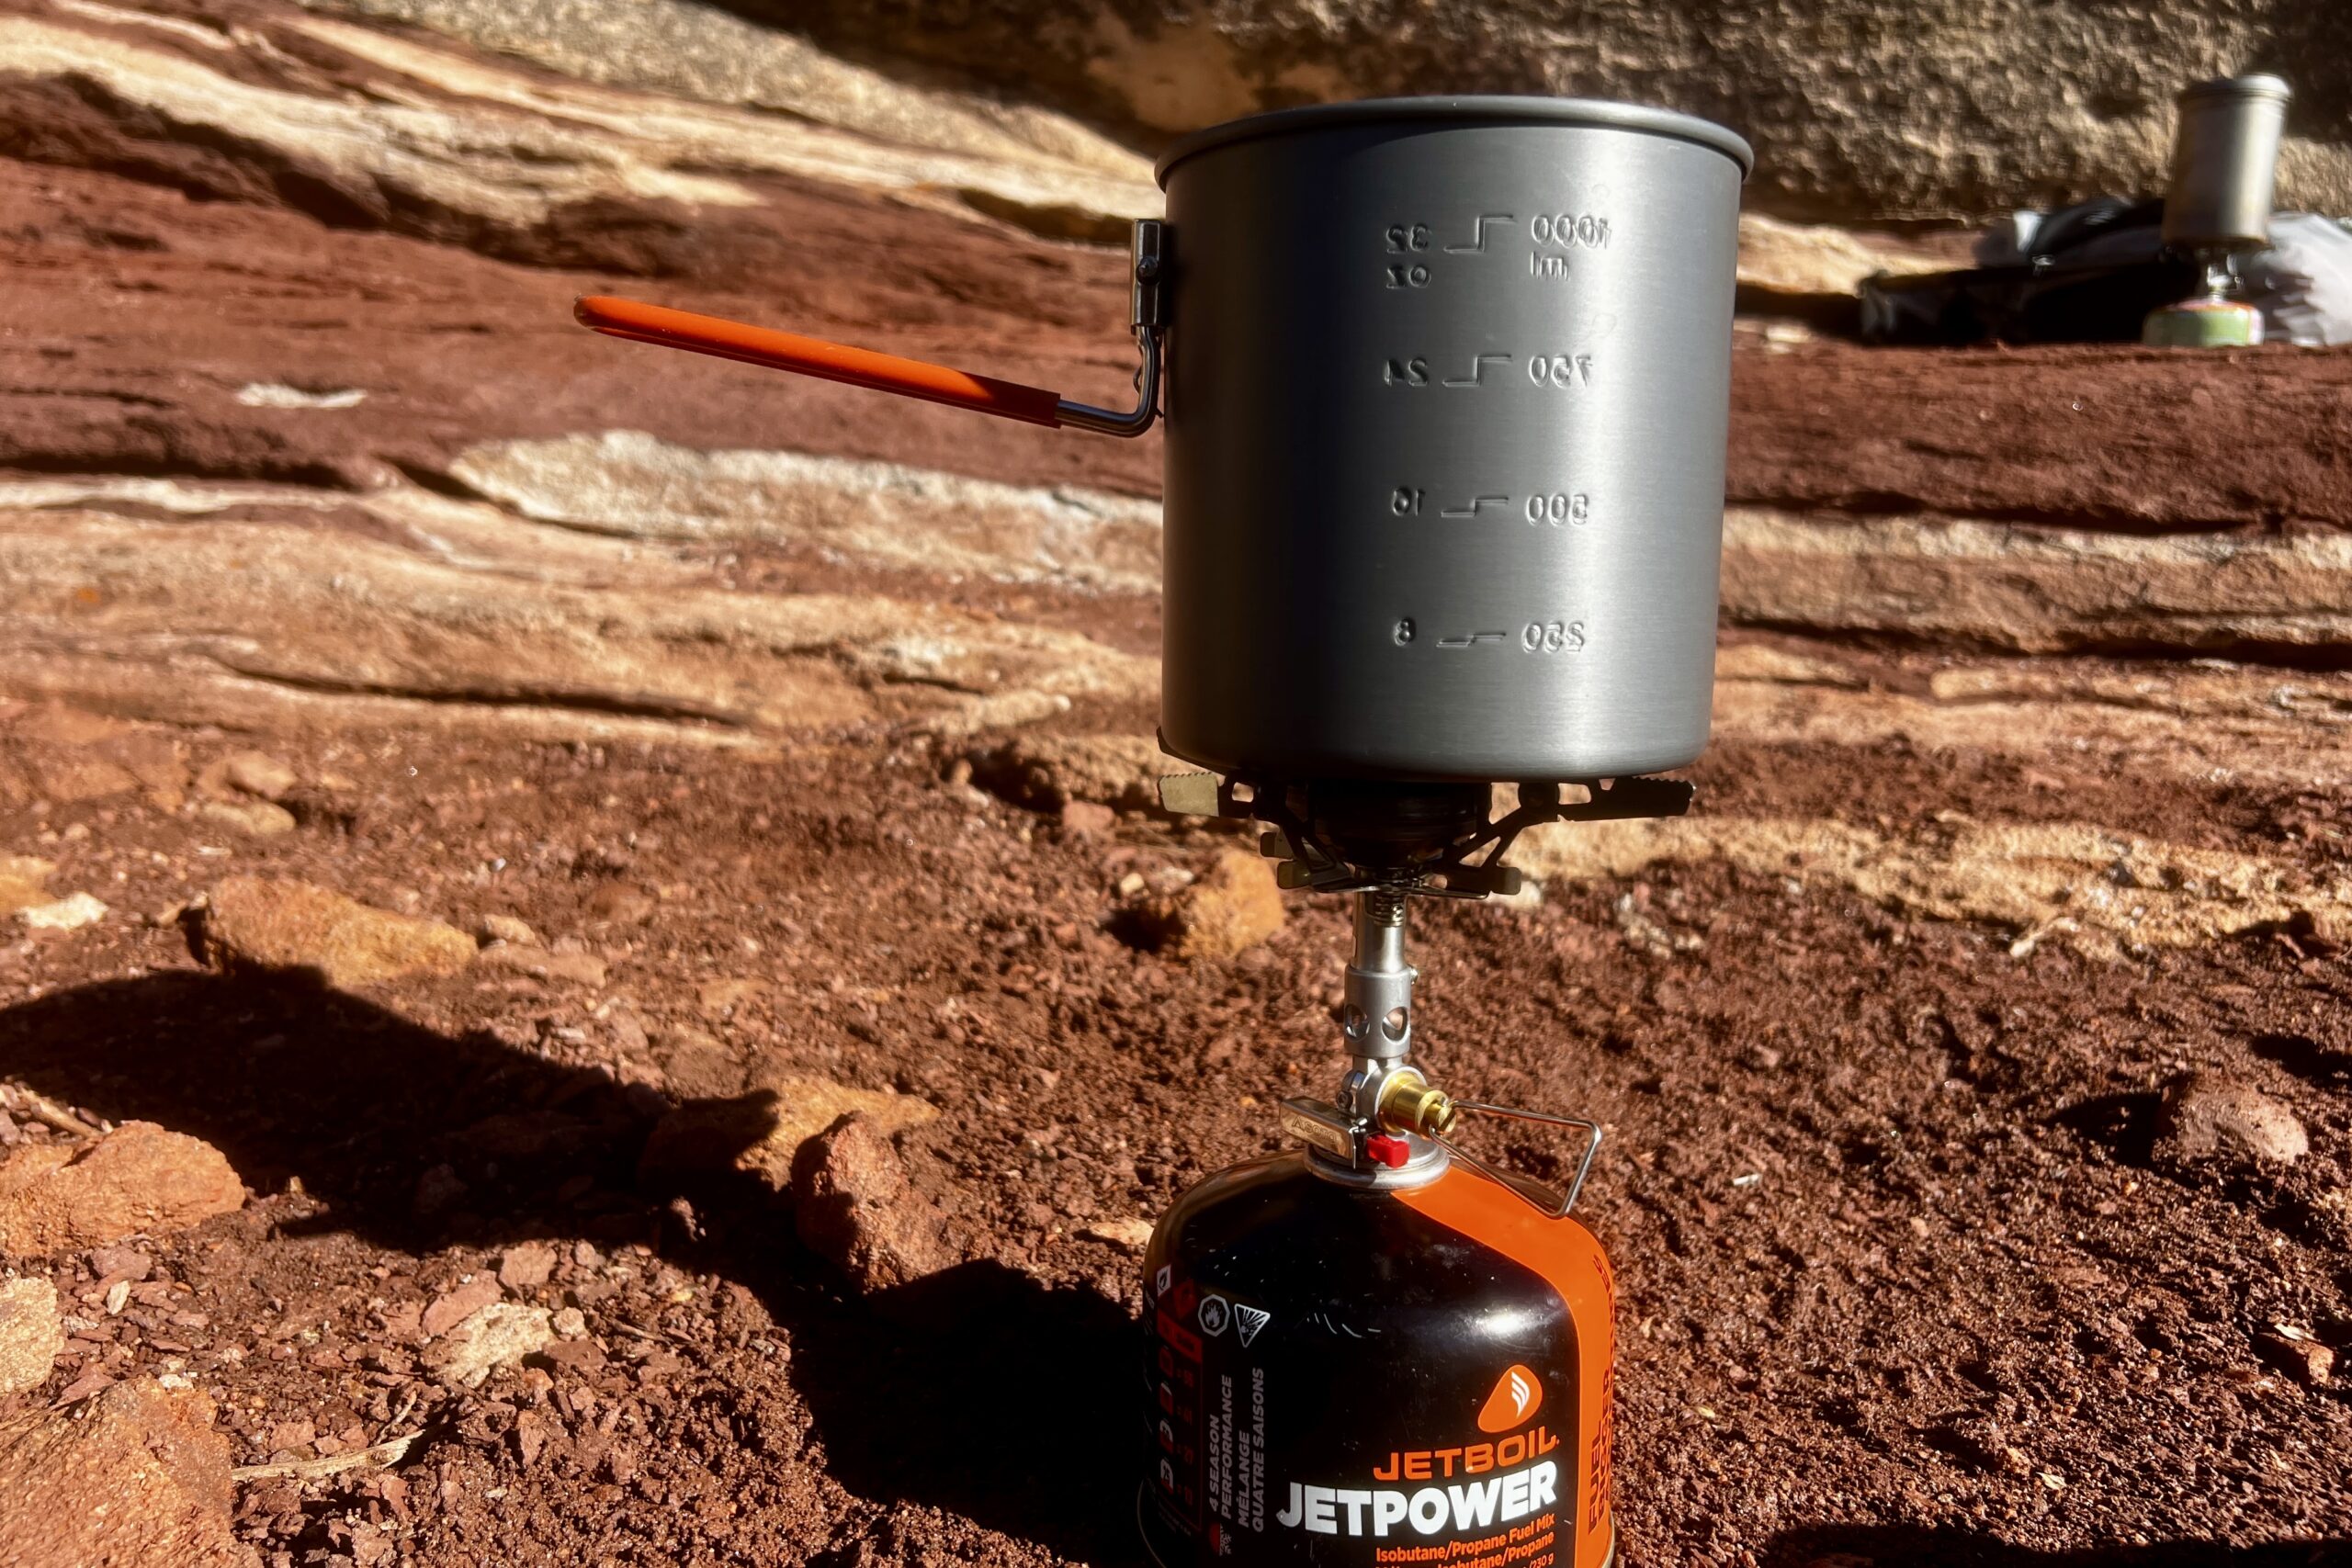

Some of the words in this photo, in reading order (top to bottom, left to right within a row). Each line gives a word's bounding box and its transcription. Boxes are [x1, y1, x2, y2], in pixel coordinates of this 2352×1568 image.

[1221, 1374, 1233, 1520] PERFORMANCE
[1251, 1367, 1265, 1449] SAISONS
[1208, 1414, 1220, 1496] SEASON
[1235, 1429, 1250, 1529] MÉLANGE
[1251, 1450, 1265, 1533] QUATRE
[1373, 1426, 1557, 1481] JETBOIL
[1588, 1420, 1601, 1535] FUEL
[1208, 1498, 1219, 1512] 4
[1276, 1461, 1557, 1537] JETPOWER
[1375, 1534, 1508, 1562] Isobutane/Propane
[1509, 1521, 1535, 1543] Fuel
[1536, 1513, 1555, 1533] Mix
[1438, 1531, 1555, 1568] butane/Propane
